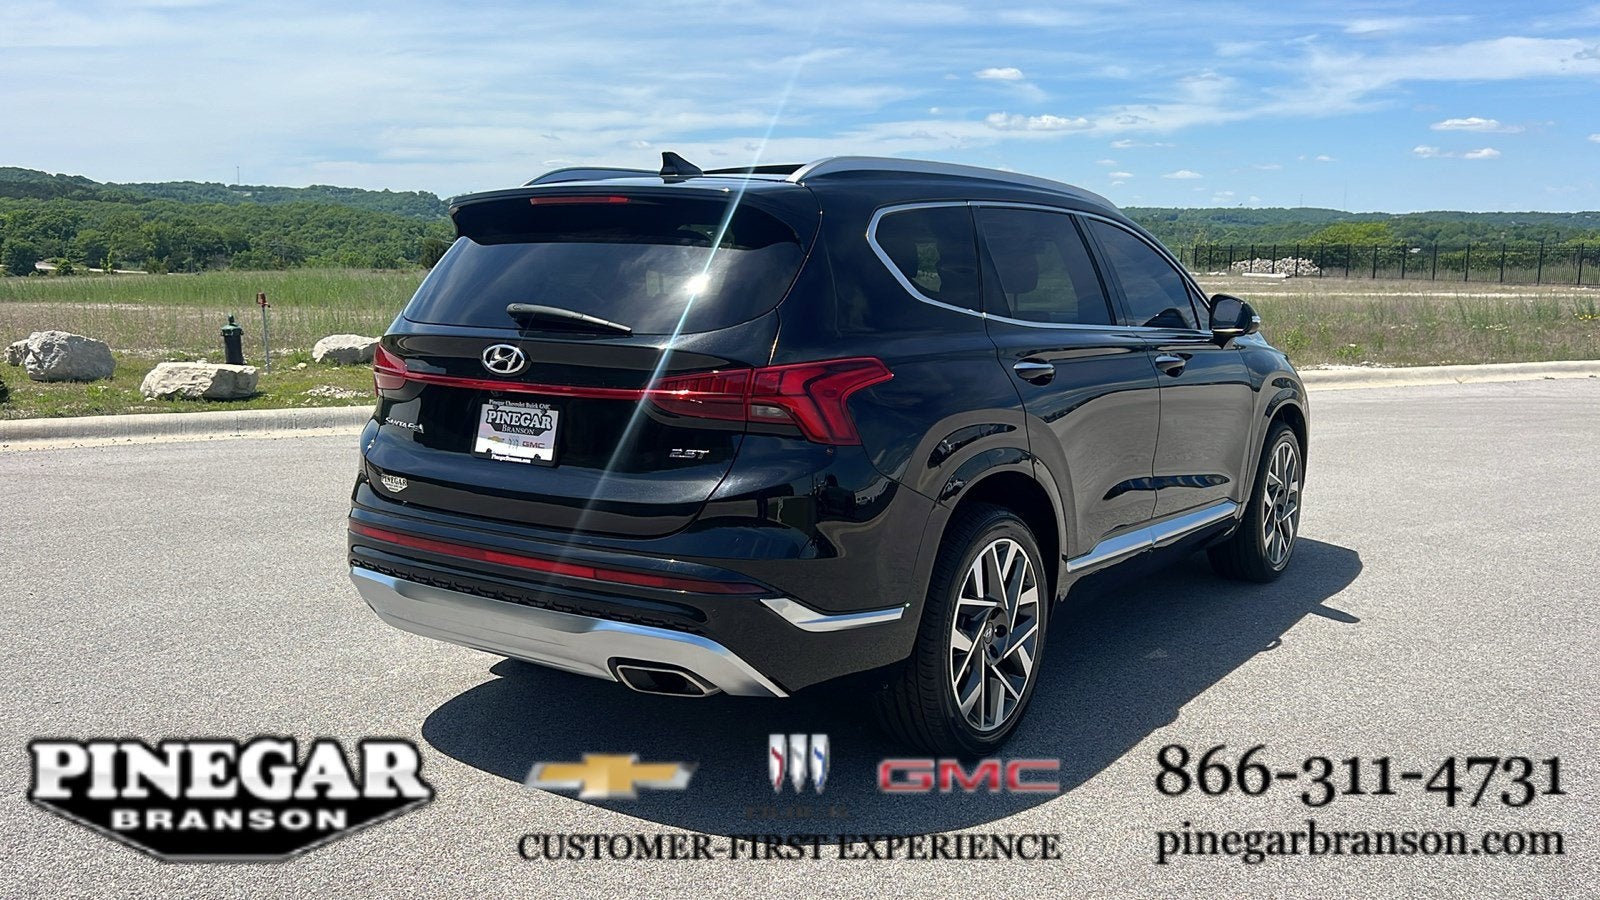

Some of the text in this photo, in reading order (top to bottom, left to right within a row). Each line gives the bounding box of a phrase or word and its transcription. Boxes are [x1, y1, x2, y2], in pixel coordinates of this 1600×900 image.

[487, 410, 552, 429] PINEGAR
[502, 424, 535, 435] BRANSON
[522, 440, 545, 449] GMC
